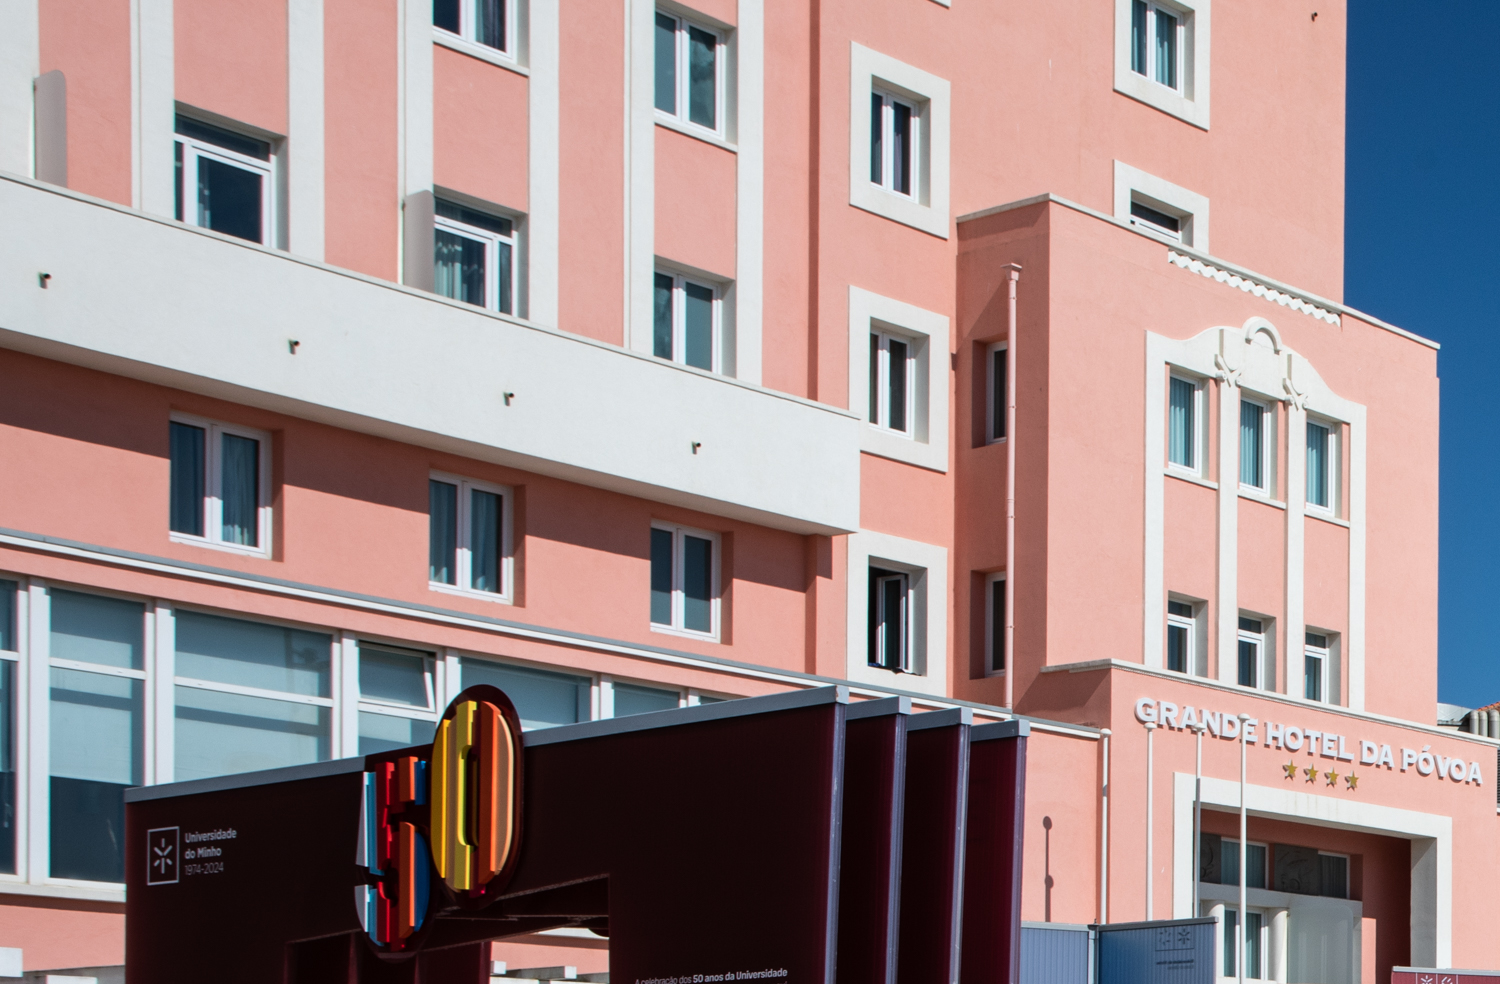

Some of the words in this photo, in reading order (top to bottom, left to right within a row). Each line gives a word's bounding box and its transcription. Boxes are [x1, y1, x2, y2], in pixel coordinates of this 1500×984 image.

[1135, 697, 1258, 743] GRANDE
[1265, 721, 1354, 760] HOTEL
[1361, 740, 1394, 768] DA
[1400, 745, 1483, 784] PÓVOA
[185, 828, 237, 843] Universidade
[185, 849, 195, 859] do
[197, 846, 222, 858] Minho
[185, 862, 224, 875] 1974-2024
[679, 976, 691, 984] dos
[693, 974, 703, 983] 50
[705, 974, 723, 982] anos
[725, 972, 734, 980] da
[737, 969, 787, 980] Universidade
